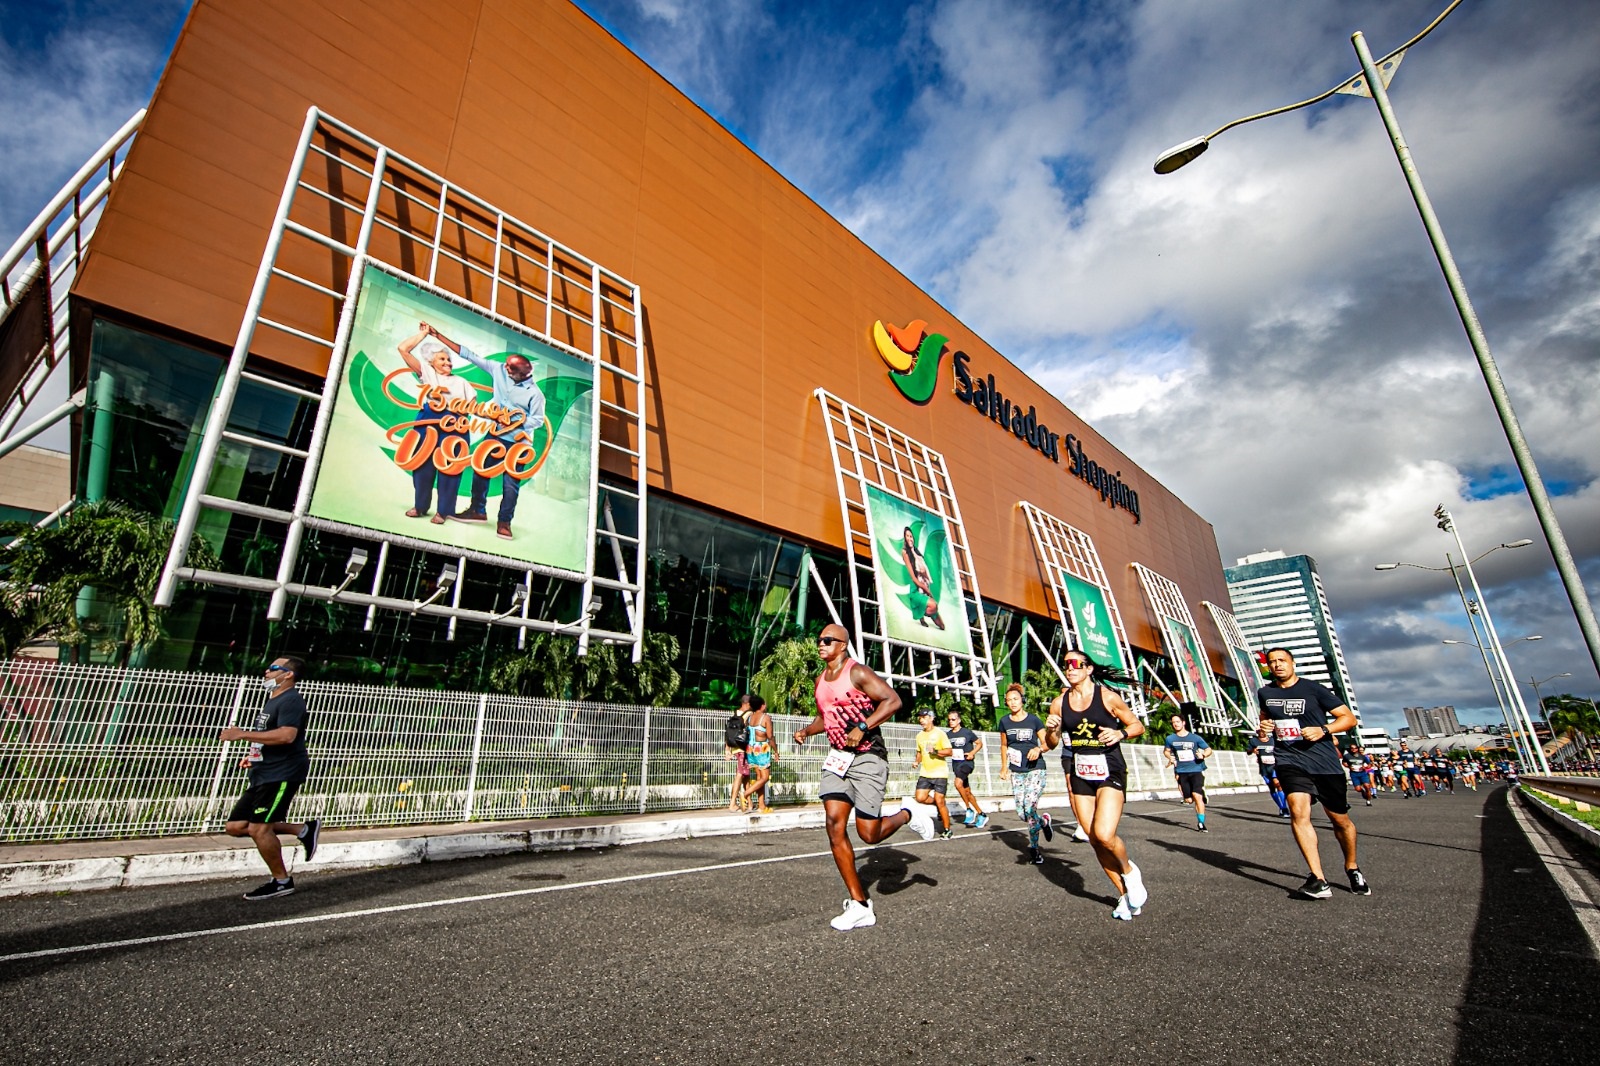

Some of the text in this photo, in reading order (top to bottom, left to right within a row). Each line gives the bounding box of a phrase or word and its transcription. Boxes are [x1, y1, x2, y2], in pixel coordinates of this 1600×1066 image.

[416, 383, 526, 426] 15 anos
[439, 414, 502, 436] com
[953, 351, 1141, 524] Salvador Shopping
